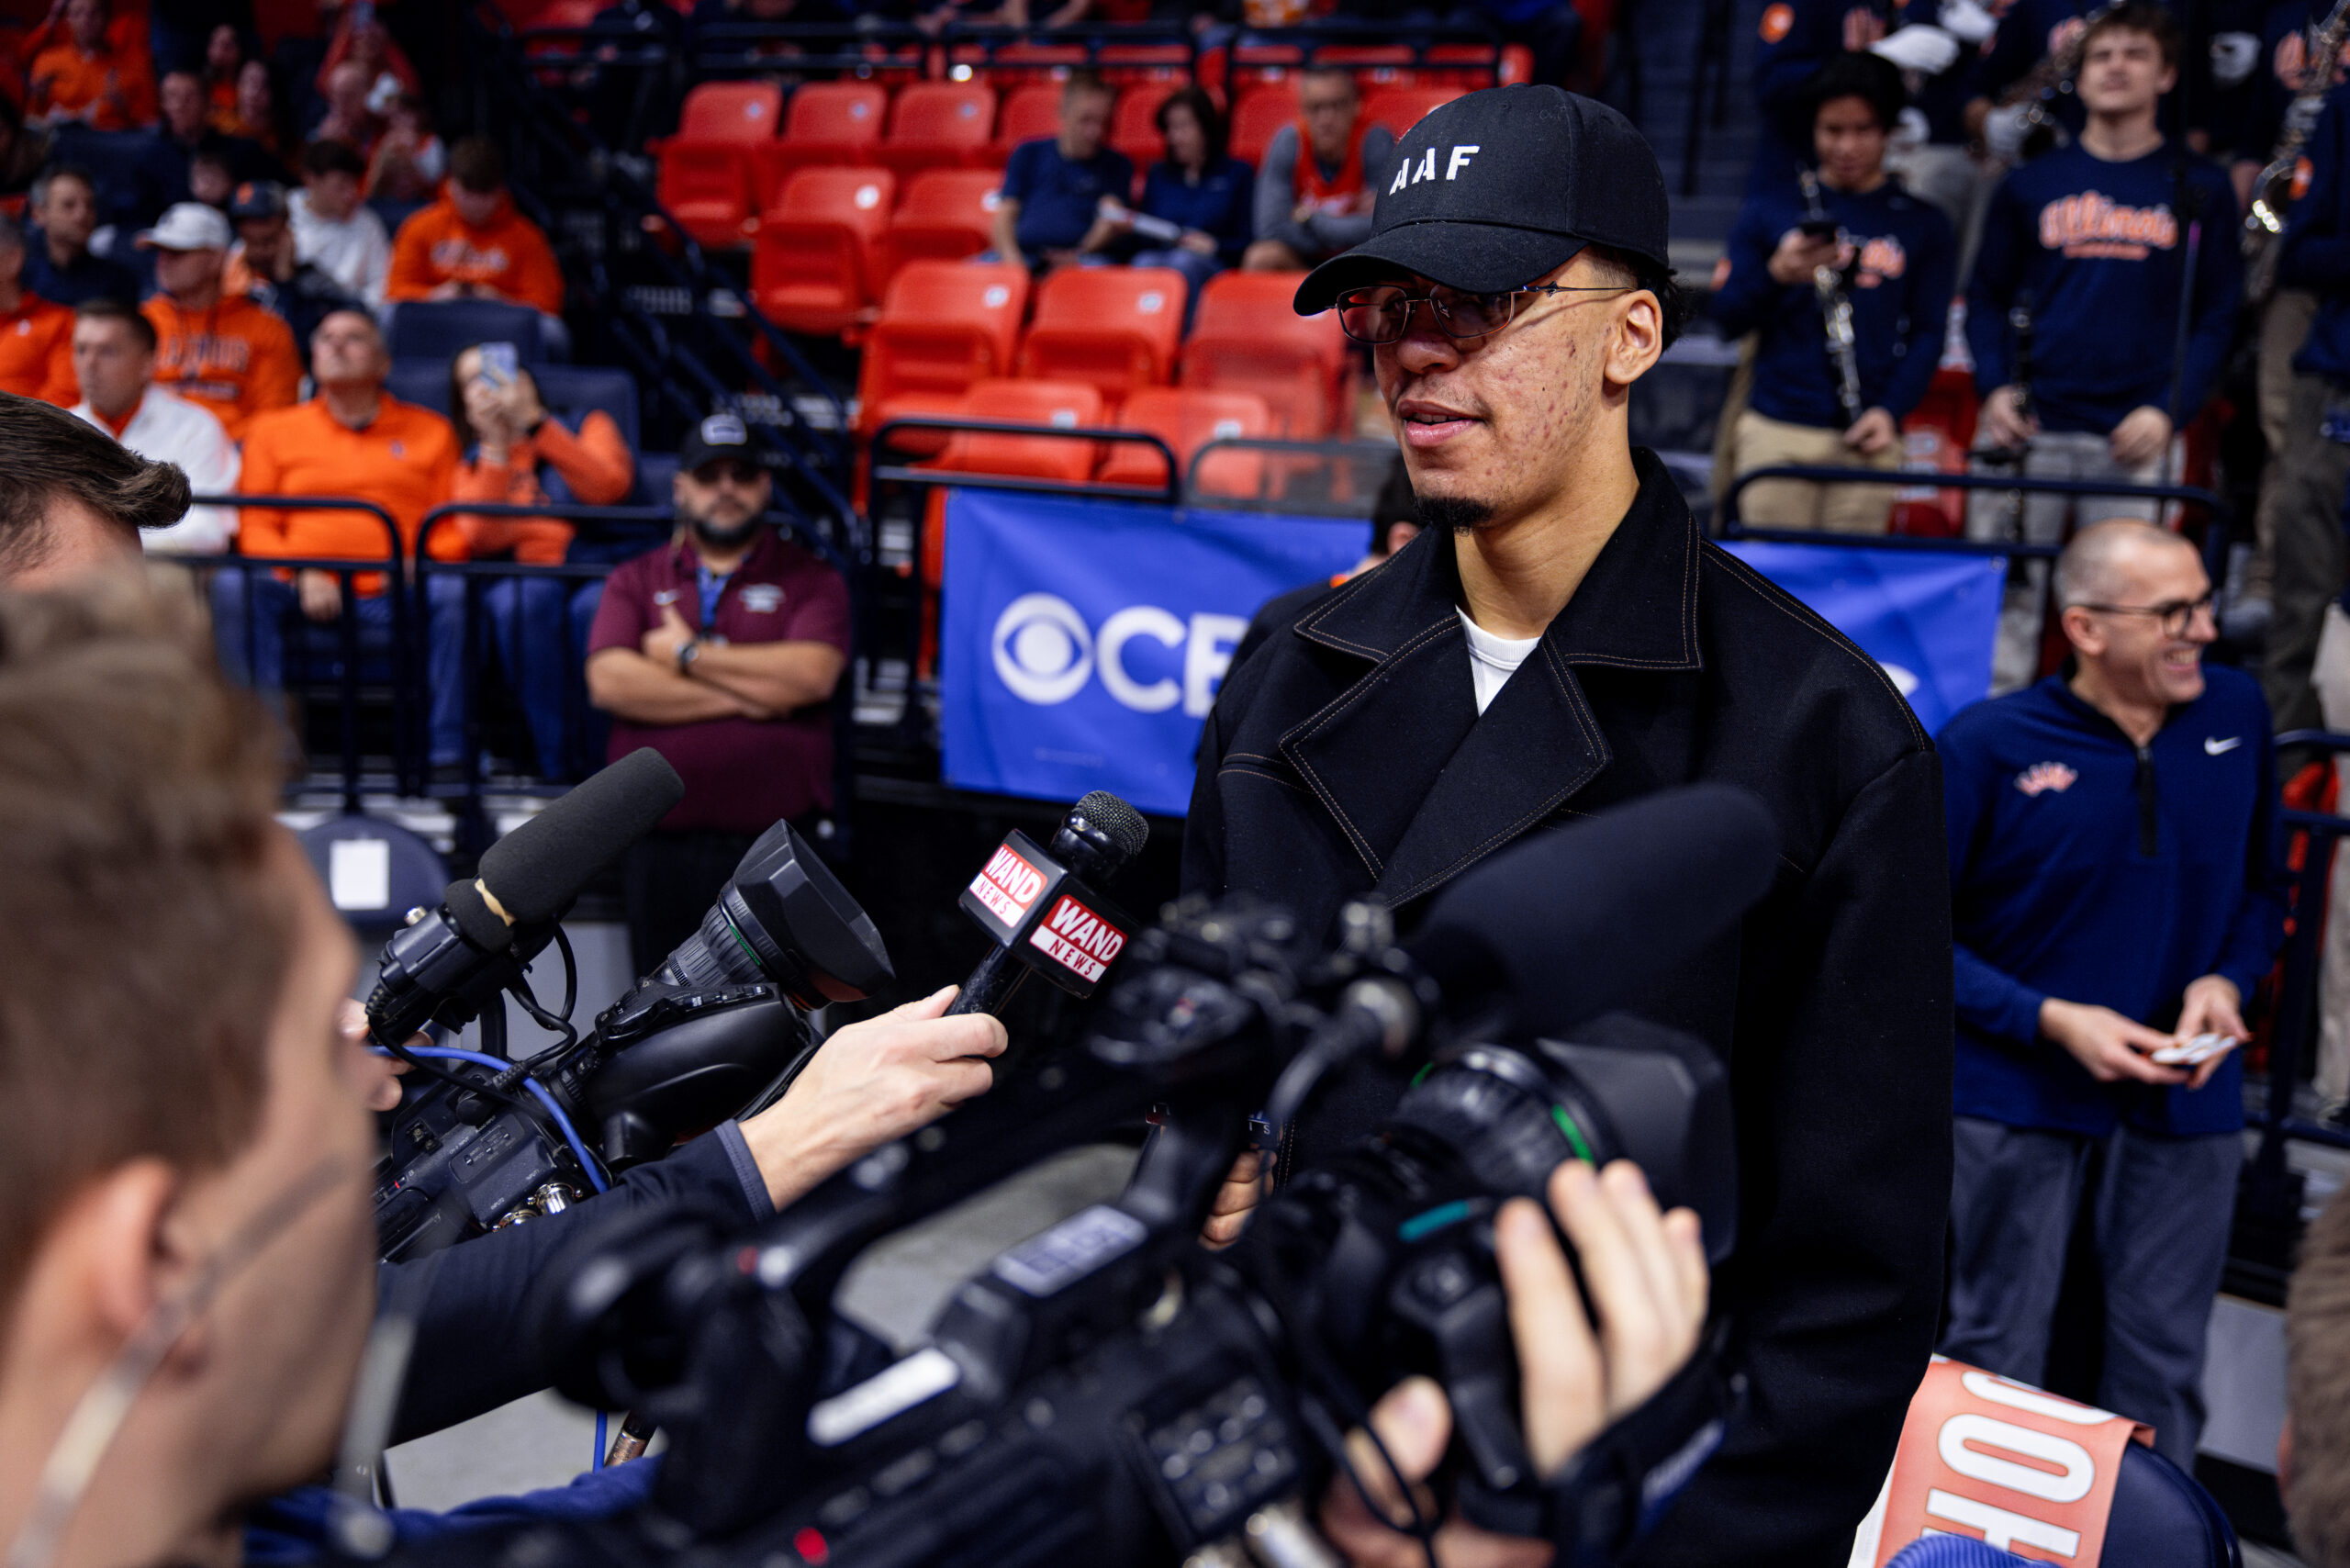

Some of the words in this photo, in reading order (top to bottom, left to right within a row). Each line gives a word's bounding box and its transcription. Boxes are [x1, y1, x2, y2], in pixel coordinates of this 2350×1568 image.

[1389, 145, 1481, 196] AAF
[977, 879, 1008, 914] NEWS
[984, 846, 1042, 903] WAND
[1050, 898, 1124, 962] WAND
[1048, 939, 1097, 976] NEWS
